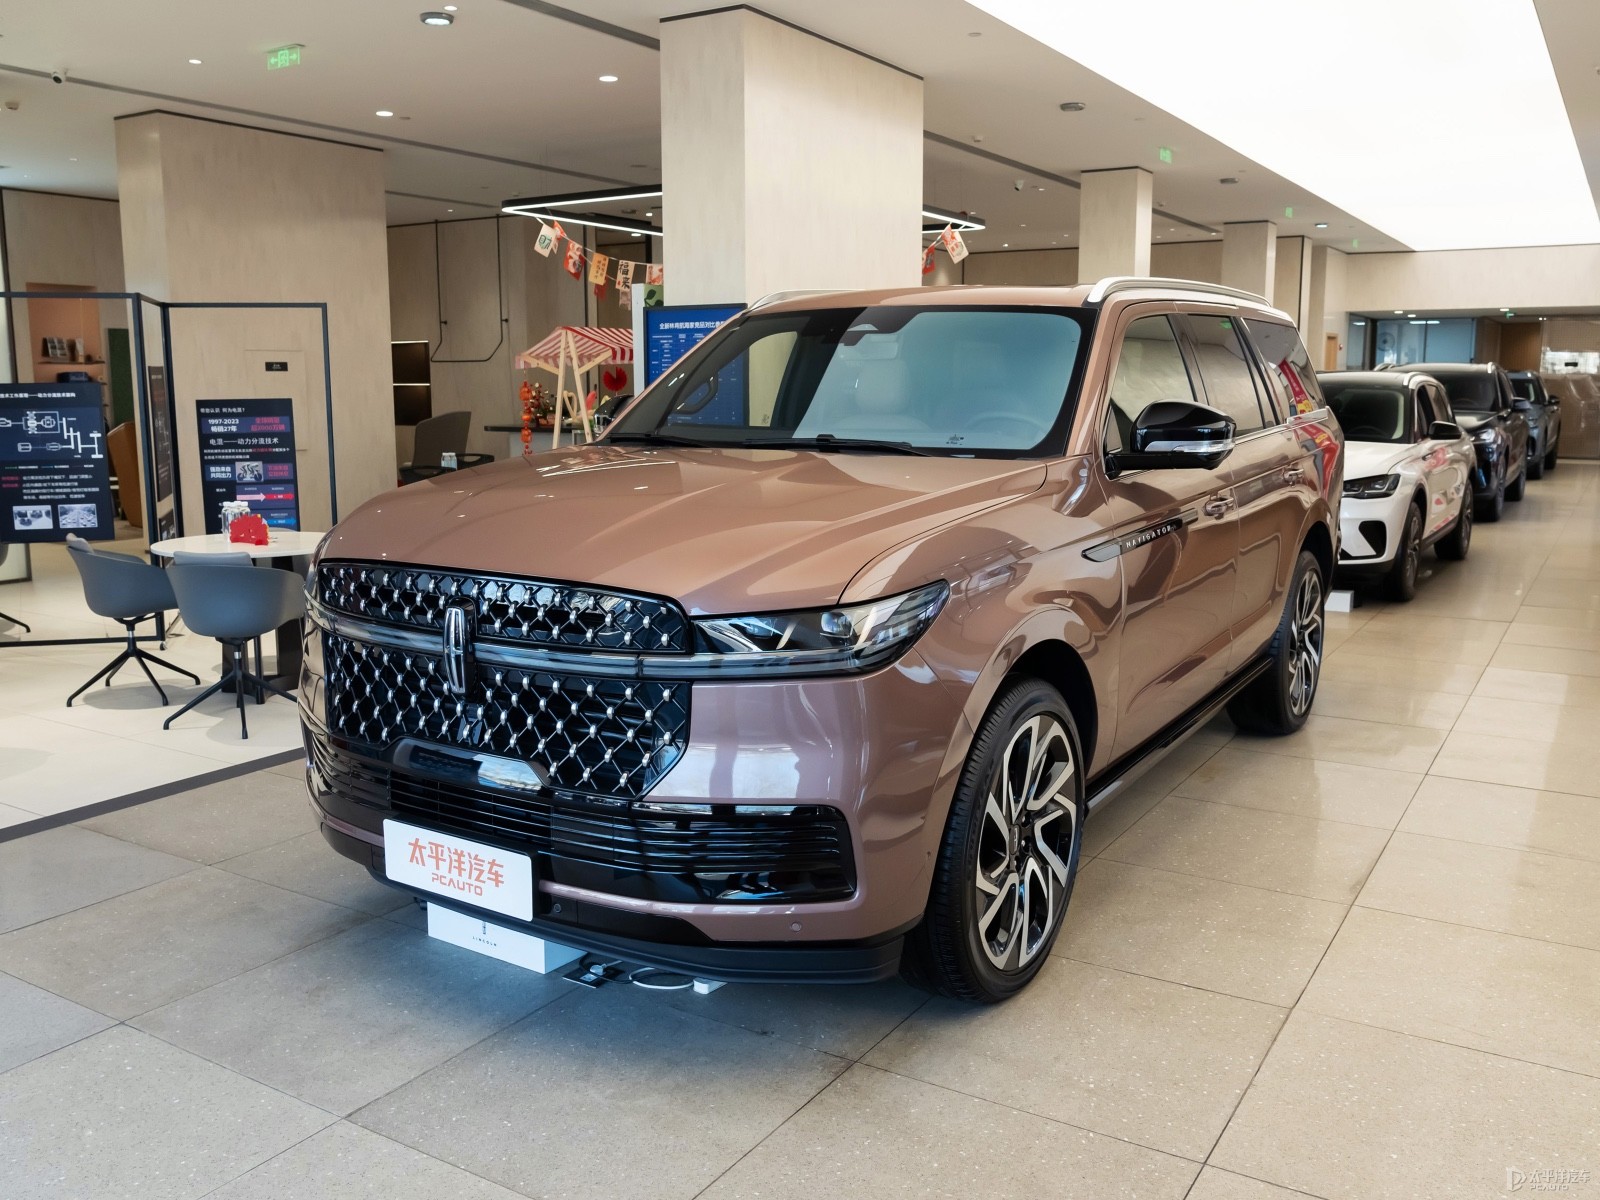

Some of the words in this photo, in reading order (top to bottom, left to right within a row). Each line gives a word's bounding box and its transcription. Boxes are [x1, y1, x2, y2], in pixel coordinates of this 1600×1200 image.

[1126, 525, 1171, 548] NAVIGATOR
[408, 837, 505, 888] 太平洋汽车
[431, 872, 483, 896] PCAUTO
[472, 935, 497, 947] LINCOLN
